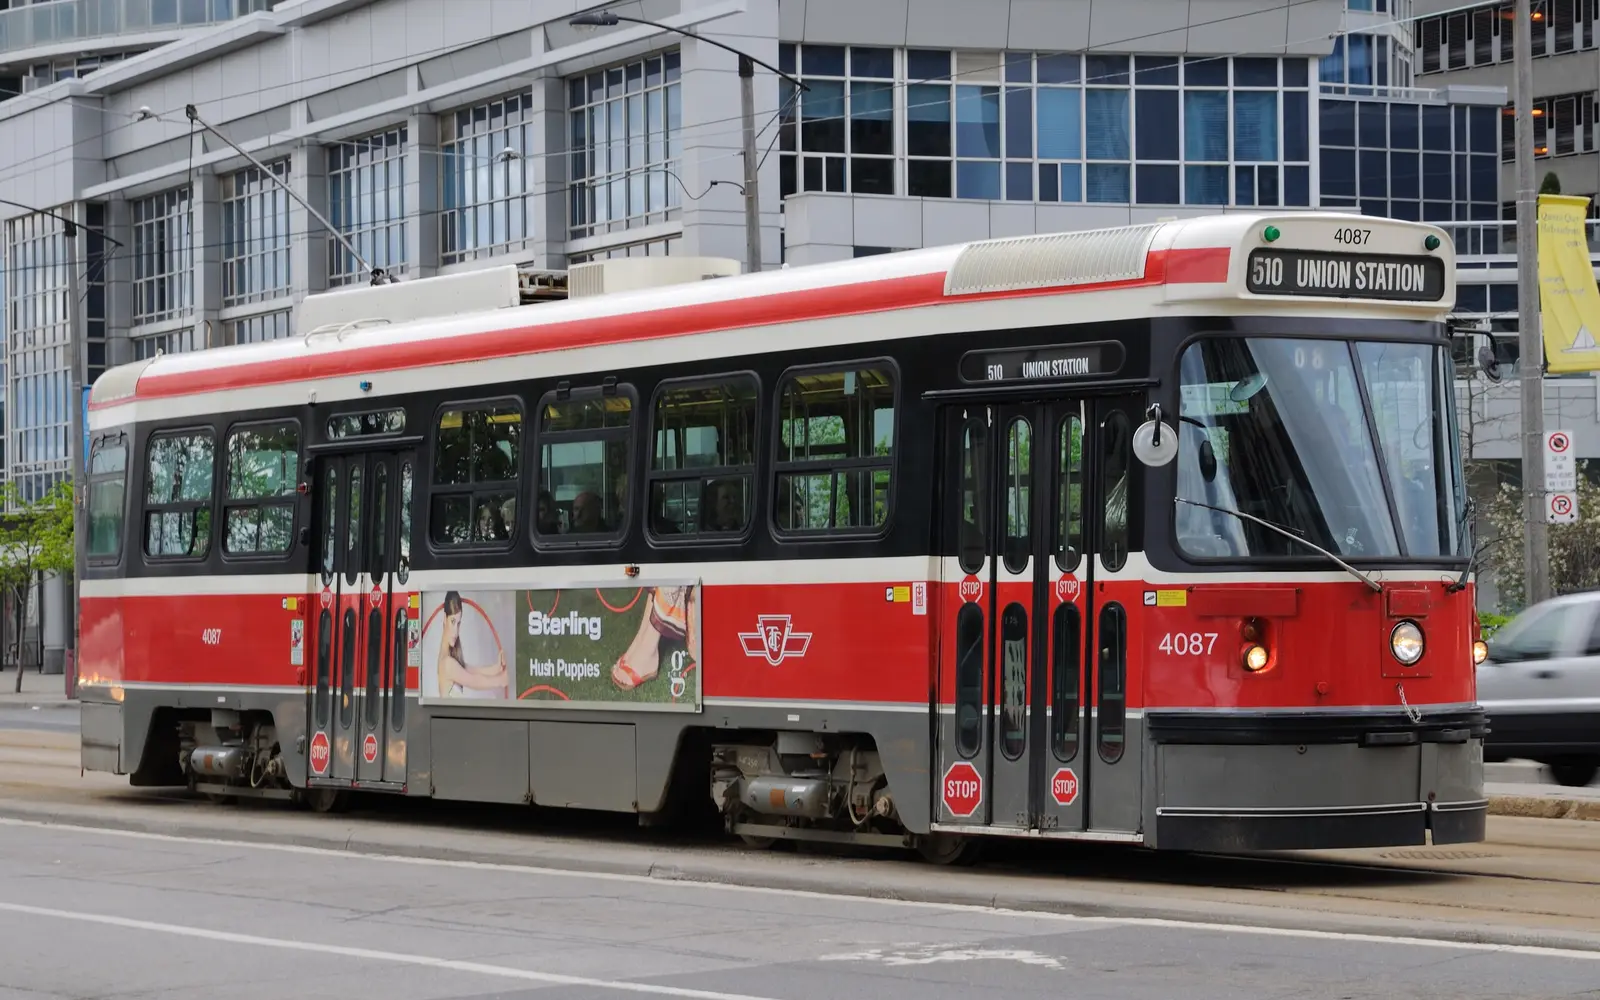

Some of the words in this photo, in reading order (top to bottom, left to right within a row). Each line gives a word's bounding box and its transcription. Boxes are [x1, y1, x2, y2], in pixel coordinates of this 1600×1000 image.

[1334, 228, 1371, 245] 4087
[1252, 257, 1283, 286] 510
[1296, 258, 1351, 289] UNION
[1355, 261, 1425, 292] STATION
[987, 364, 1003, 380] 510
[1022, 360, 1051, 379] UNION
[1051, 357, 1089, 376] STATION
[962, 581, 980, 595] STOP
[1059, 580, 1077, 594] STOP
[528, 610, 602, 640] Sterling
[202, 628, 222, 645] 4087
[1158, 632, 1219, 656] 4087
[529, 658, 555, 677] Hush
[556, 659, 601, 682] Puppies
[312, 745, 328, 760] STOP
[365, 742, 376, 754] STOP
[947, 780, 978, 799] STOP
[1054, 779, 1075, 795] STOP
